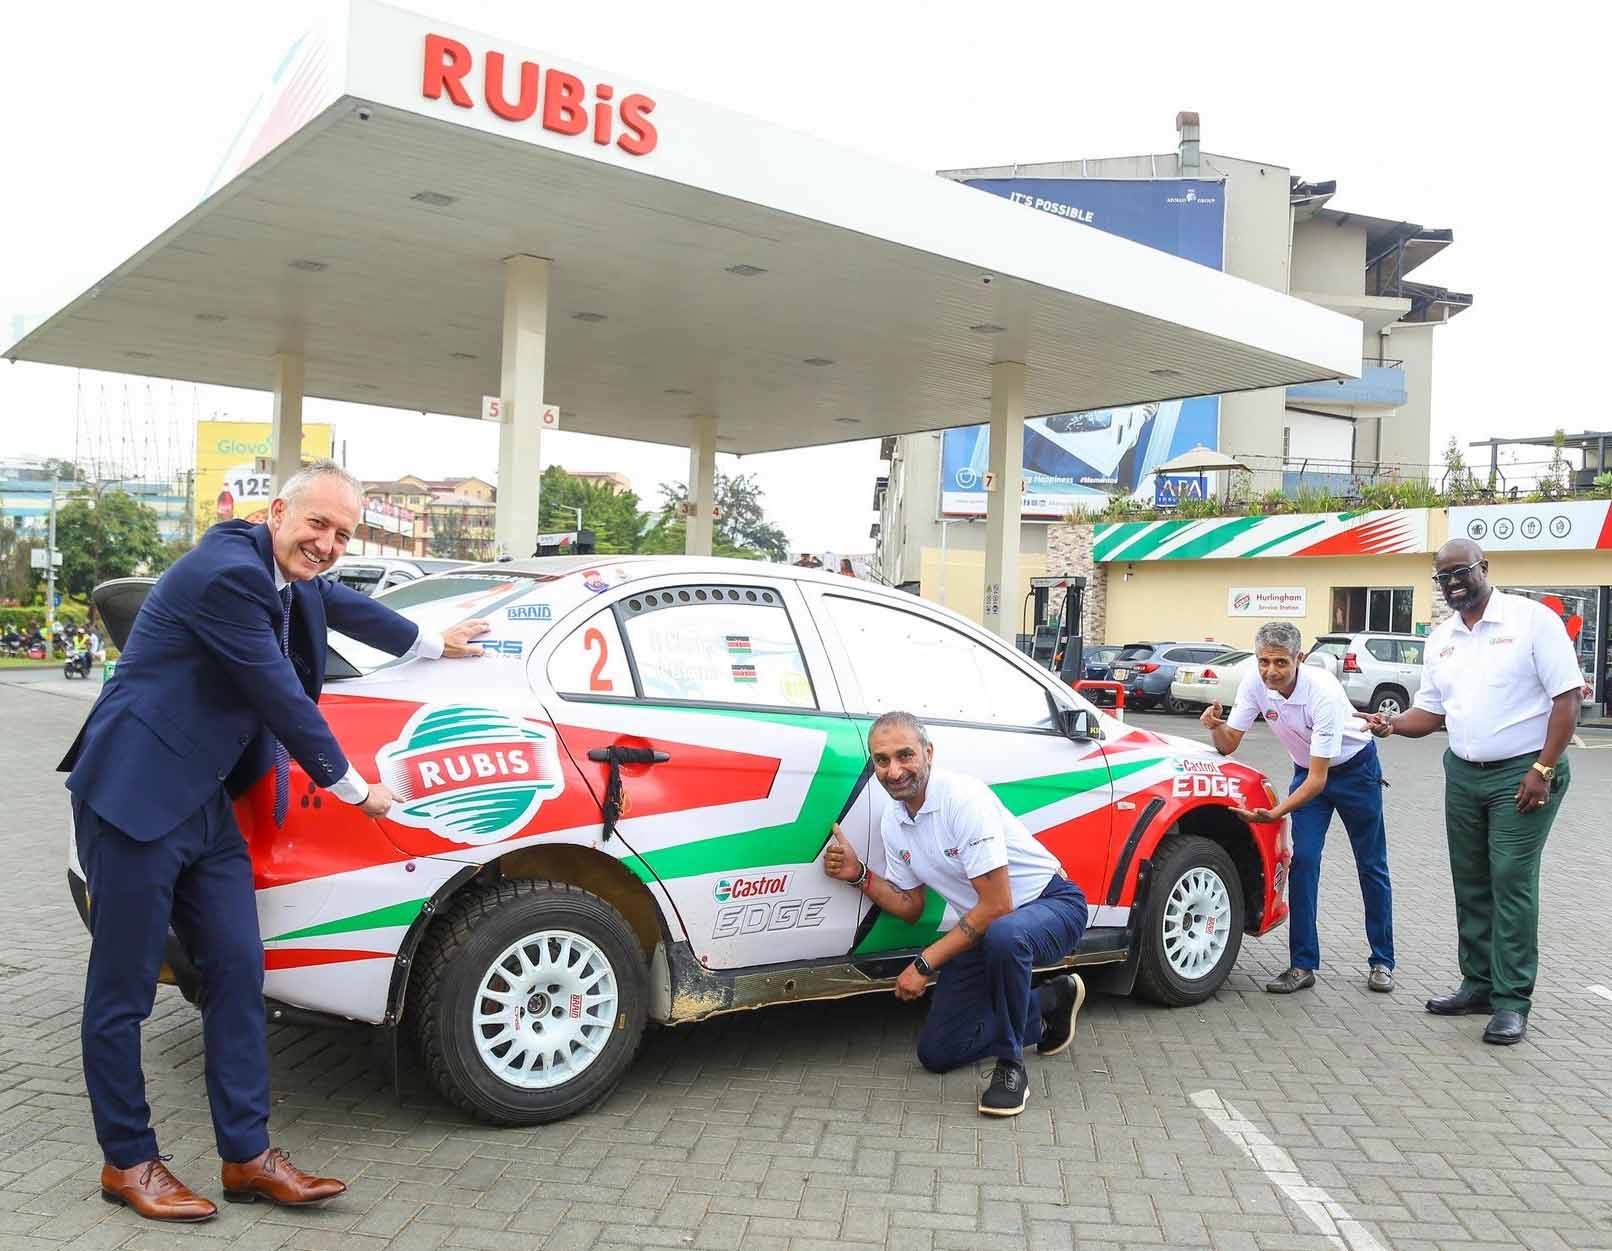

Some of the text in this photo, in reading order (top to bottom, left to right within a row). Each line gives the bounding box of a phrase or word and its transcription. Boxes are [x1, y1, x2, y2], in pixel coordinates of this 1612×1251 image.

[423, 33, 658, 156] RUBiS
[1010, 191, 1094, 223] IT'S POSSIBLE
[489, 401, 499, 417] 5
[543, 409, 554, 424] 6
[217, 439, 268, 454] Glovo
[985, 475, 993, 488] 7
[681, 503, 689, 513] 3
[712, 507, 720, 517] 4
[1256, 593, 1302, 603] Hurlingham
[507, 605, 552, 619] BRAID
[583, 627, 613, 691] 2
[417, 750, 530, 789] RUBiS
[1183, 759, 1218, 772] Castrol
[1172, 775, 1244, 799] EDGE
[731, 874, 788, 899] Castrol
[712, 896, 832, 940] EDGE
